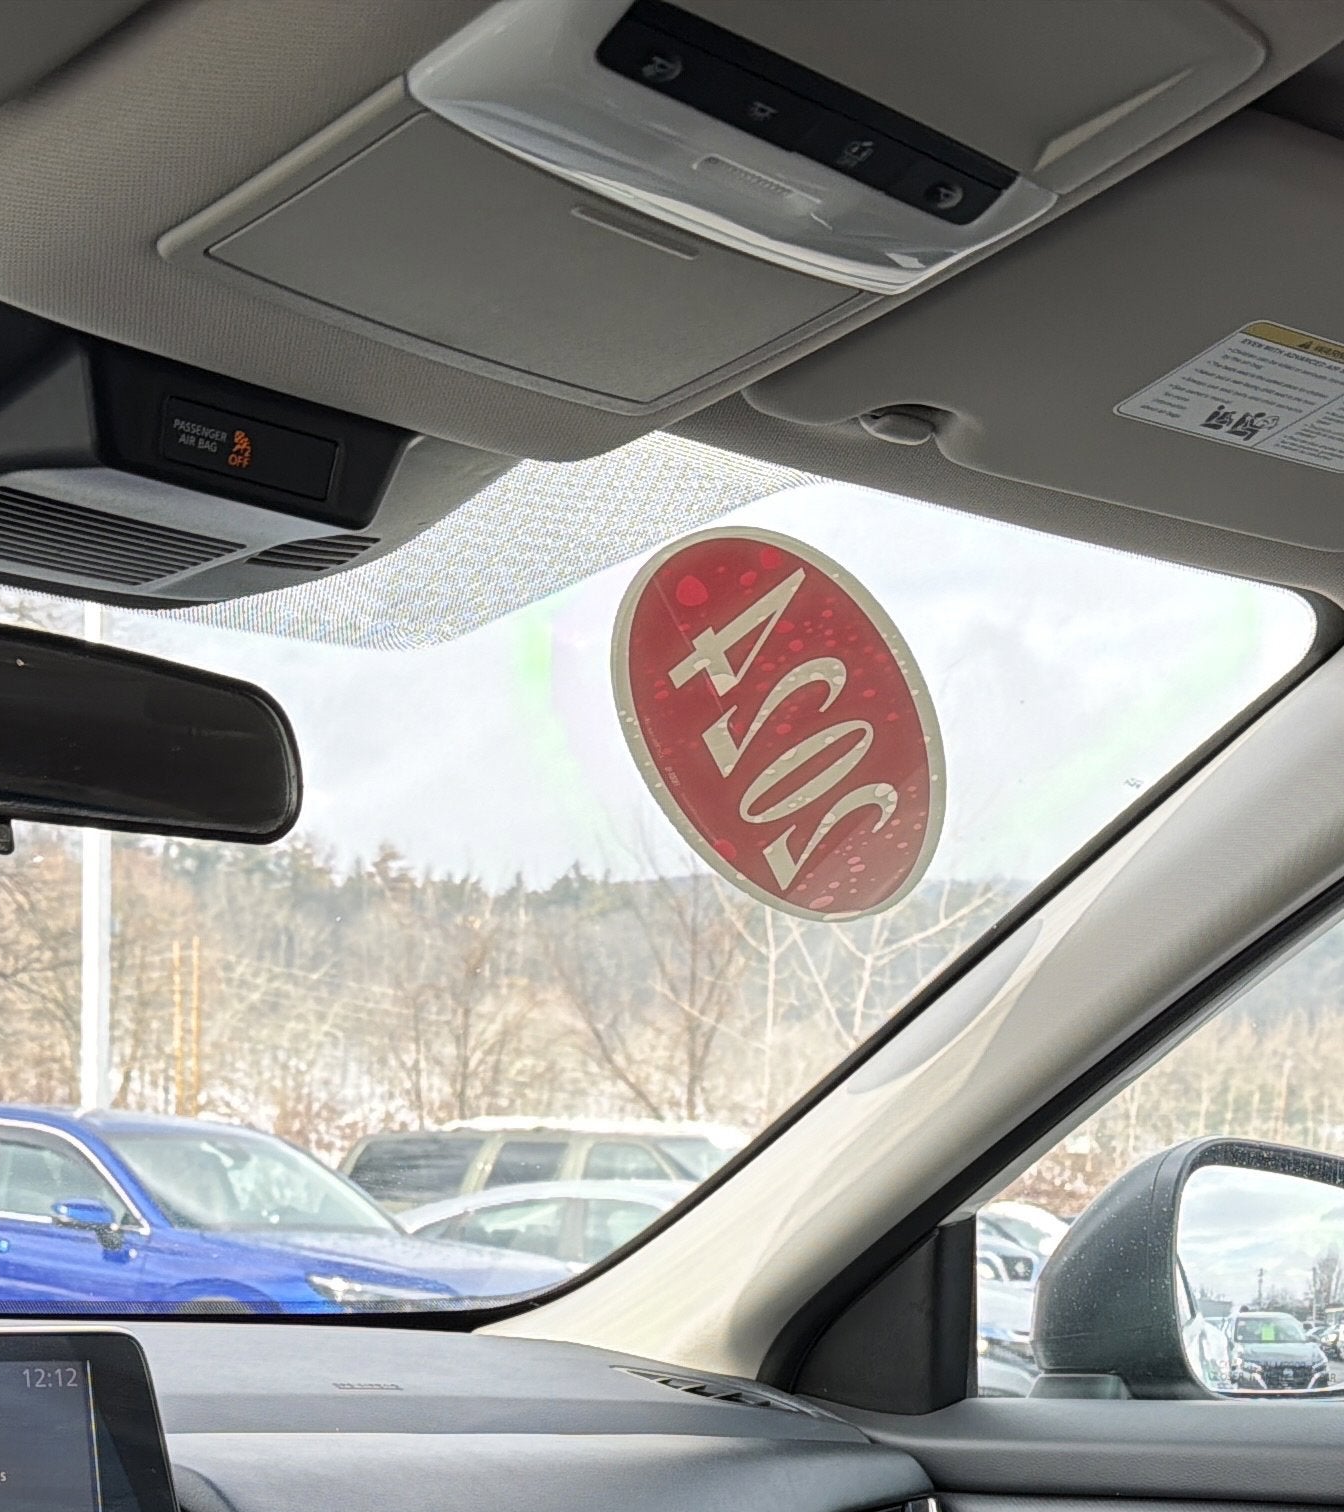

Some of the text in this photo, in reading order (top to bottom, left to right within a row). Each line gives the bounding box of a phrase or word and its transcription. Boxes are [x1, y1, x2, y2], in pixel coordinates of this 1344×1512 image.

[173, 418, 228, 443] PASSENGER
[178, 433, 218, 453] AIR BAG
[228, 454, 251, 468] OFF
[22, 1368, 78, 1388] 12:12
